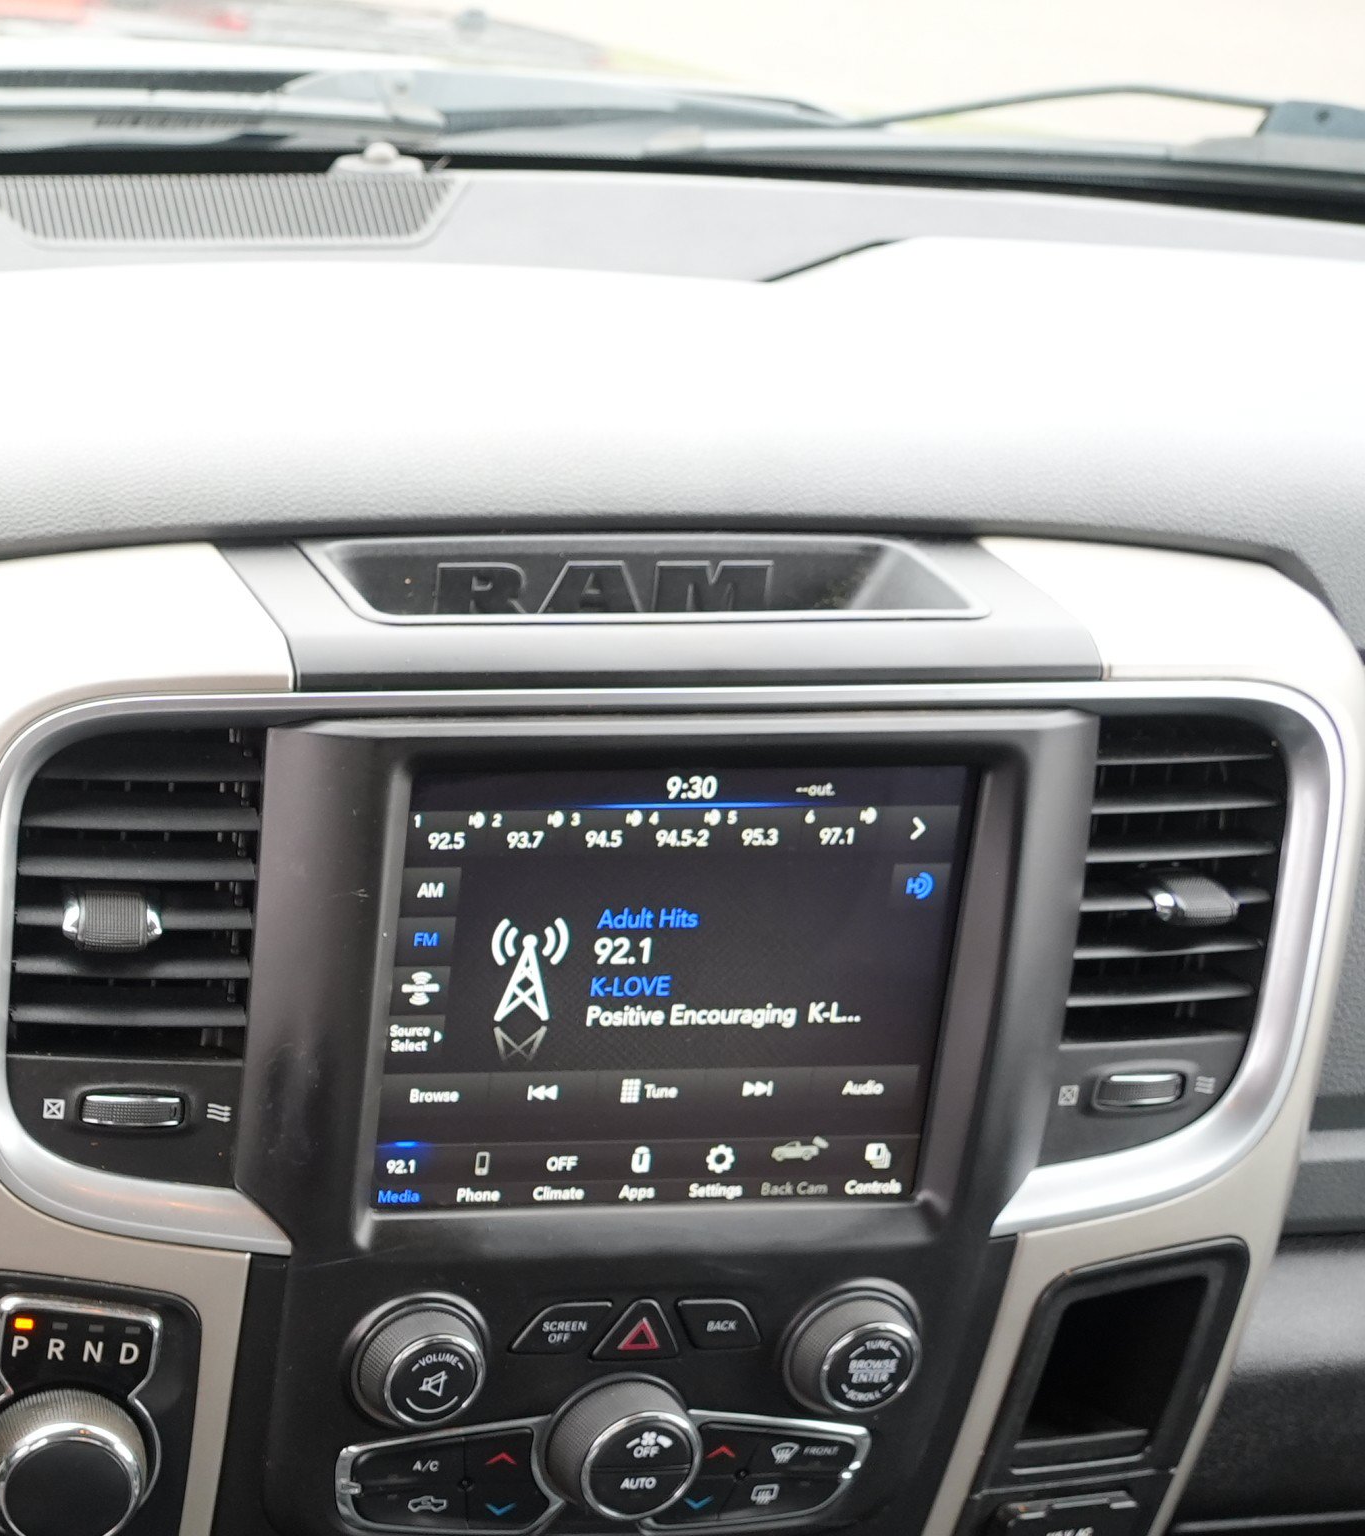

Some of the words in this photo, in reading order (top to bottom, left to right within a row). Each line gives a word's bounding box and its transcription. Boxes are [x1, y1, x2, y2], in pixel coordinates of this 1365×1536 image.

[435, 561, 772, 614] RAM
[666, 775, 718, 799] 9:30
[414, 814, 422, 828] 1
[492, 813, 502, 827] 2
[570, 812, 581, 826] 3
[649, 811, 659, 825] 4
[727, 810, 738, 825] 5
[804, 809, 816, 824] 6
[428, 831, 466, 850] 92.5
[507, 830, 545, 848] 93.7
[585, 829, 623, 848] 94.5
[655, 829, 710, 847] 94.5-2
[741, 828, 779, 846] 95.3
[819, 827, 855, 846] 97.1
[417, 882, 444, 899] AM
[597, 907, 654, 930] Adult
[659, 907, 700, 929] Hits
[413, 932, 439, 947] FM
[594, 937, 652, 965] 92.1
[590, 974, 672, 997] K-LOVE
[586, 1005, 665, 1028] Positive
[670, 1003, 797, 1029] Encouraging
[389, 1024, 431, 1038] Source
[391, 1038, 428, 1052] Select
[409, 1088, 460, 1103] Browse
[644, 1084, 679, 1099] Tune
[841, 1080, 884, 1096] Audio
[386, 1159, 417, 1175] 92.1
[546, 1155, 579, 1172] OFF
[532, 1186, 585, 1201] Climate
[619, 1185, 655, 1201] Apps
[689, 1182, 743, 1200] Settings
[760, 1181, 793, 1196] Back
[797, 1181, 829, 1195] Cam
[844, 1179, 902, 1195] Controls
[378, 1190, 420, 1204] Media
[456, 1187, 501, 1203] Phone
[542, 1321, 588, 1332] SCREEN
[706, 1321, 738, 1332] BACK
[548, 1333, 570, 1344] OFF
[11, 1335, 30, 1357] P
[47, 1337, 67, 1361] R
[82, 1339, 104, 1363] N
[118, 1341, 140, 1365] D
[418, 1353, 458, 1368] VOLUME
[633, 1447, 659, 1459] OFF
[803, 1446, 839, 1456] FRONT
[412, 1460, 440, 1472] A/C
[620, 1477, 656, 1490] AUTO
